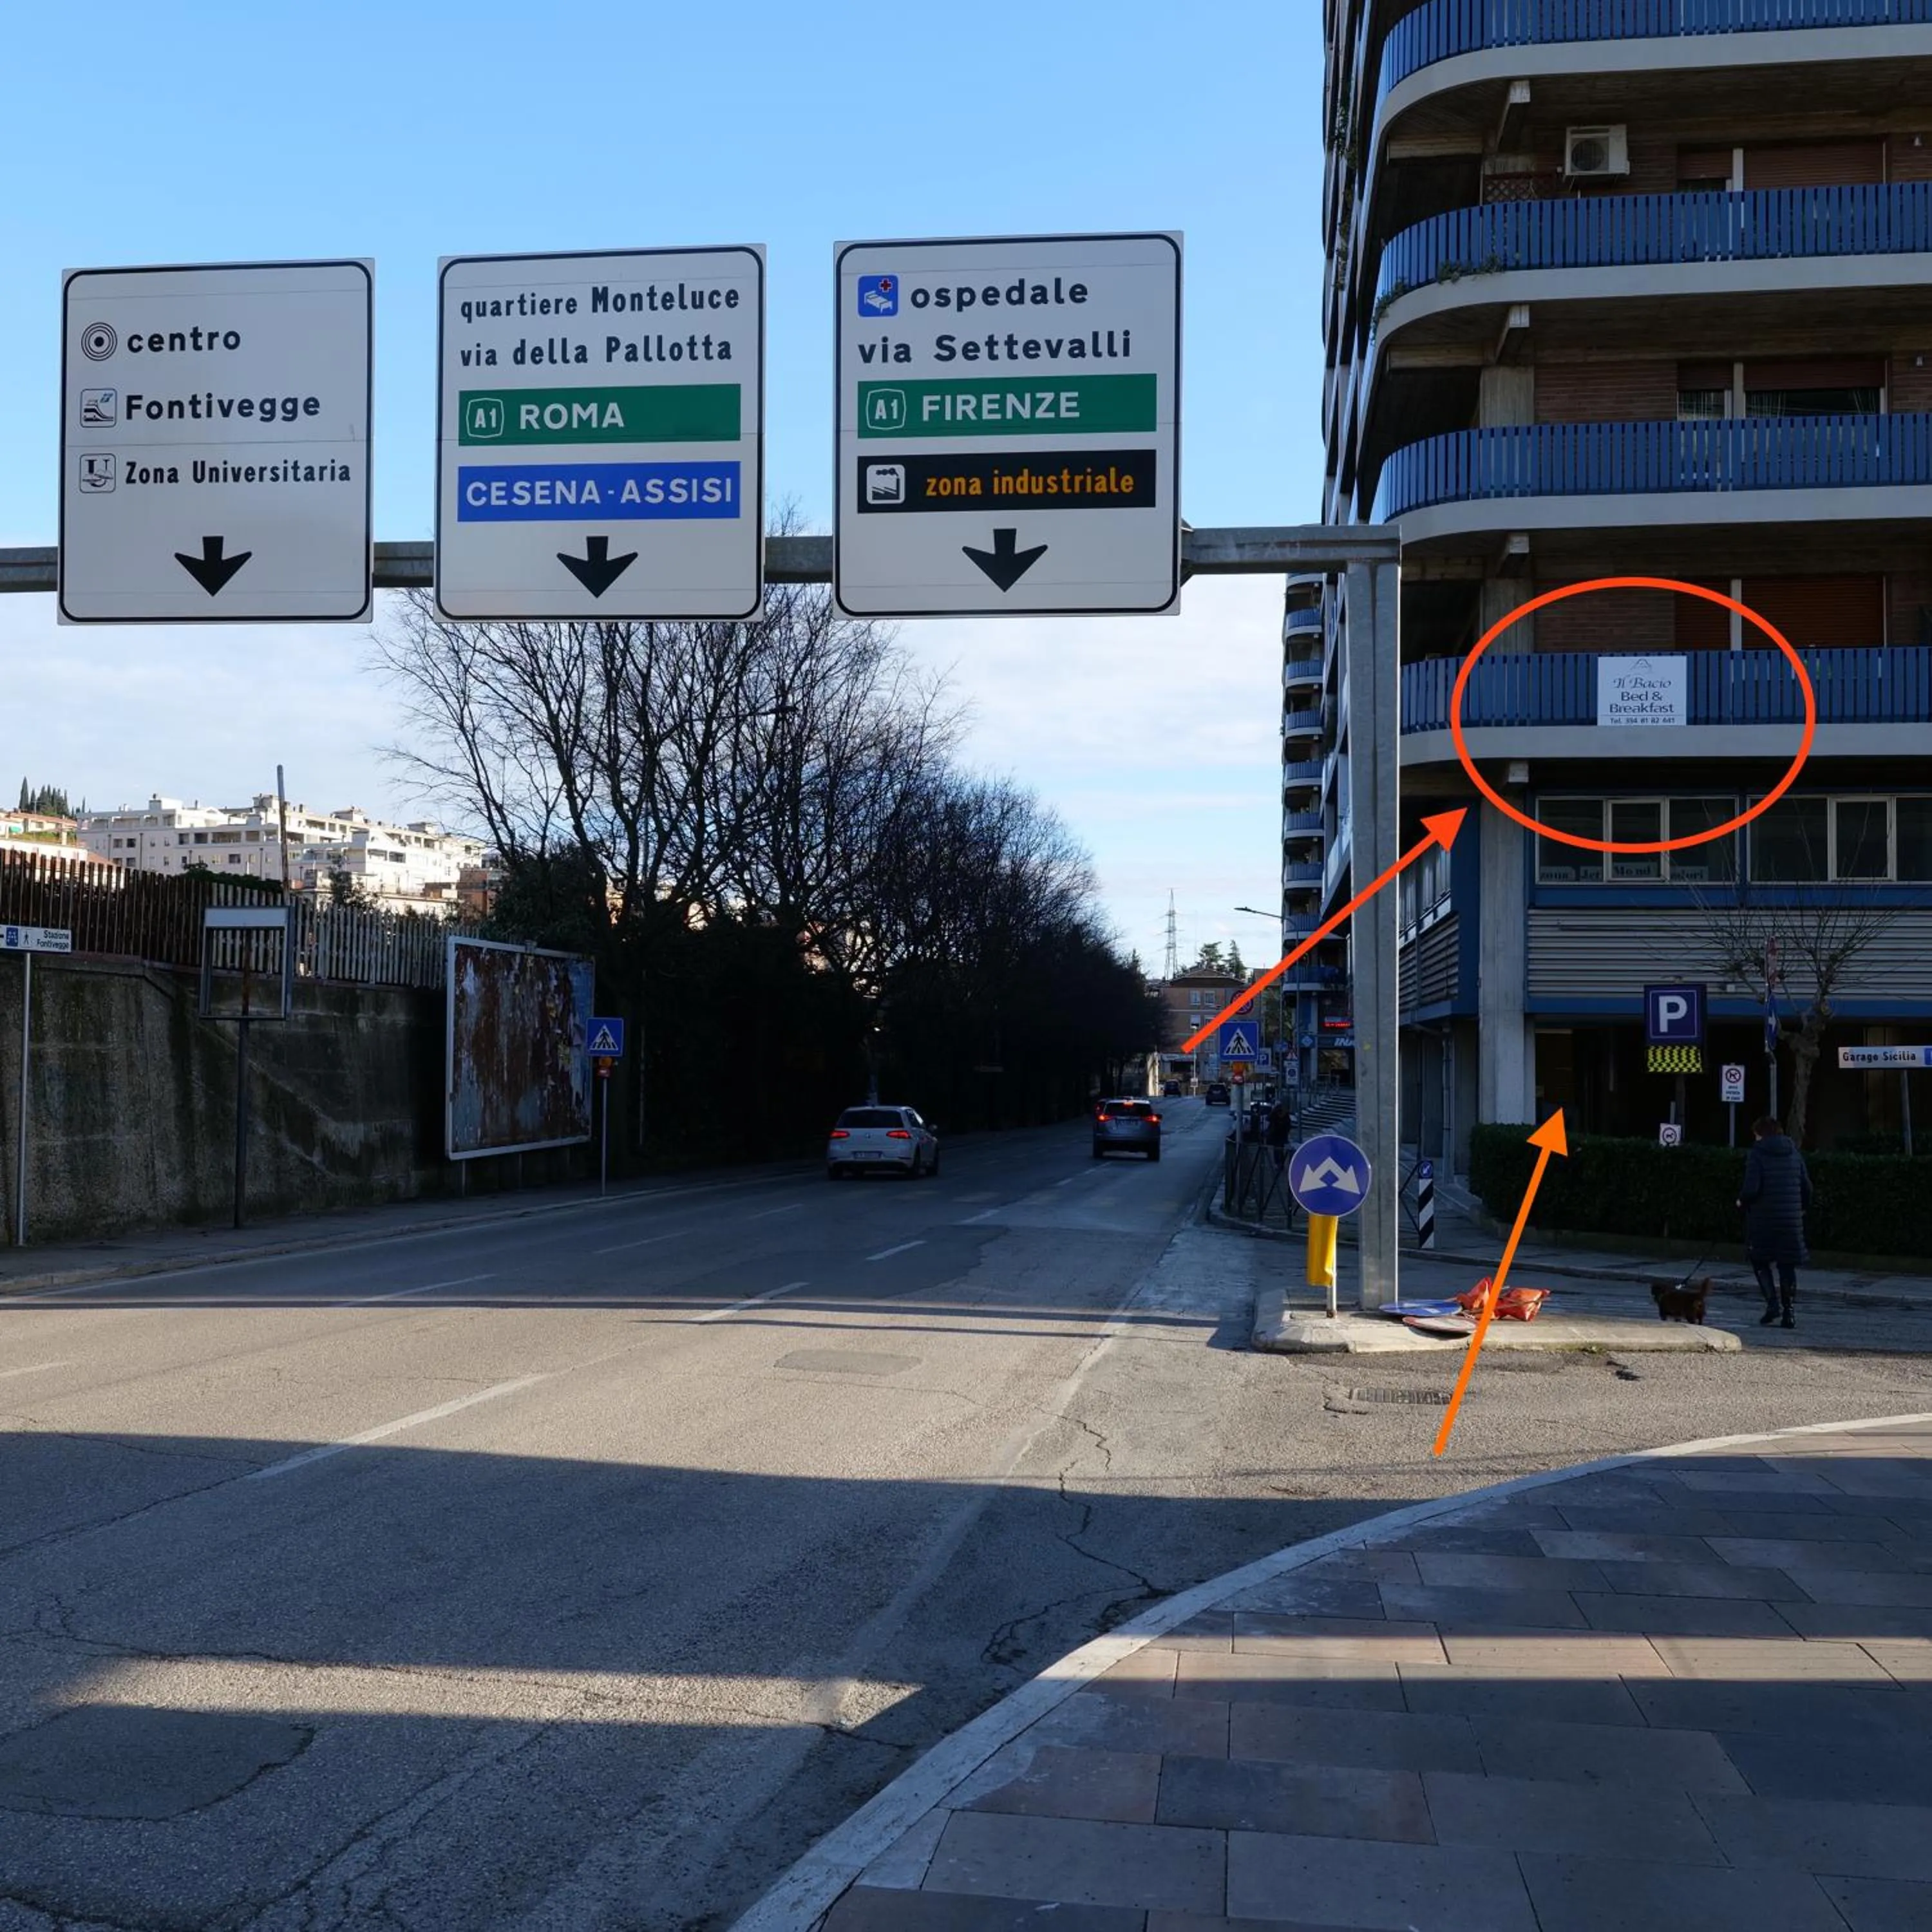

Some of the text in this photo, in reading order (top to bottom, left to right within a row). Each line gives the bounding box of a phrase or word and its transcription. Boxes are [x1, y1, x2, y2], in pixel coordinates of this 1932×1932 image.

[460, 283, 739, 324] quartiere Monteluce
[910, 277, 1088, 312] ospedale
[127, 326, 241, 354] centro
[460, 334, 732, 366] via della Pallotta
[858, 329, 1130, 364] via Settevalli
[126, 392, 320, 423] Fontivegge
[474, 408, 497, 428] A1
[520, 402, 625, 430] ROMA
[875, 399, 898, 420] A1
[922, 391, 1080, 422] FIRENZE
[125, 459, 351, 485] Zona Universitaria
[926, 467, 1134, 496] zona industriale
[1613, 676, 1672, 688] Il Bacio
[1621, 691, 1663, 701] Bed &
[1610, 703, 1674, 713] Breakfast
[1658, 995, 1687, 1032] P
[1842, 1050, 1917, 1064] Garage Sicilia
